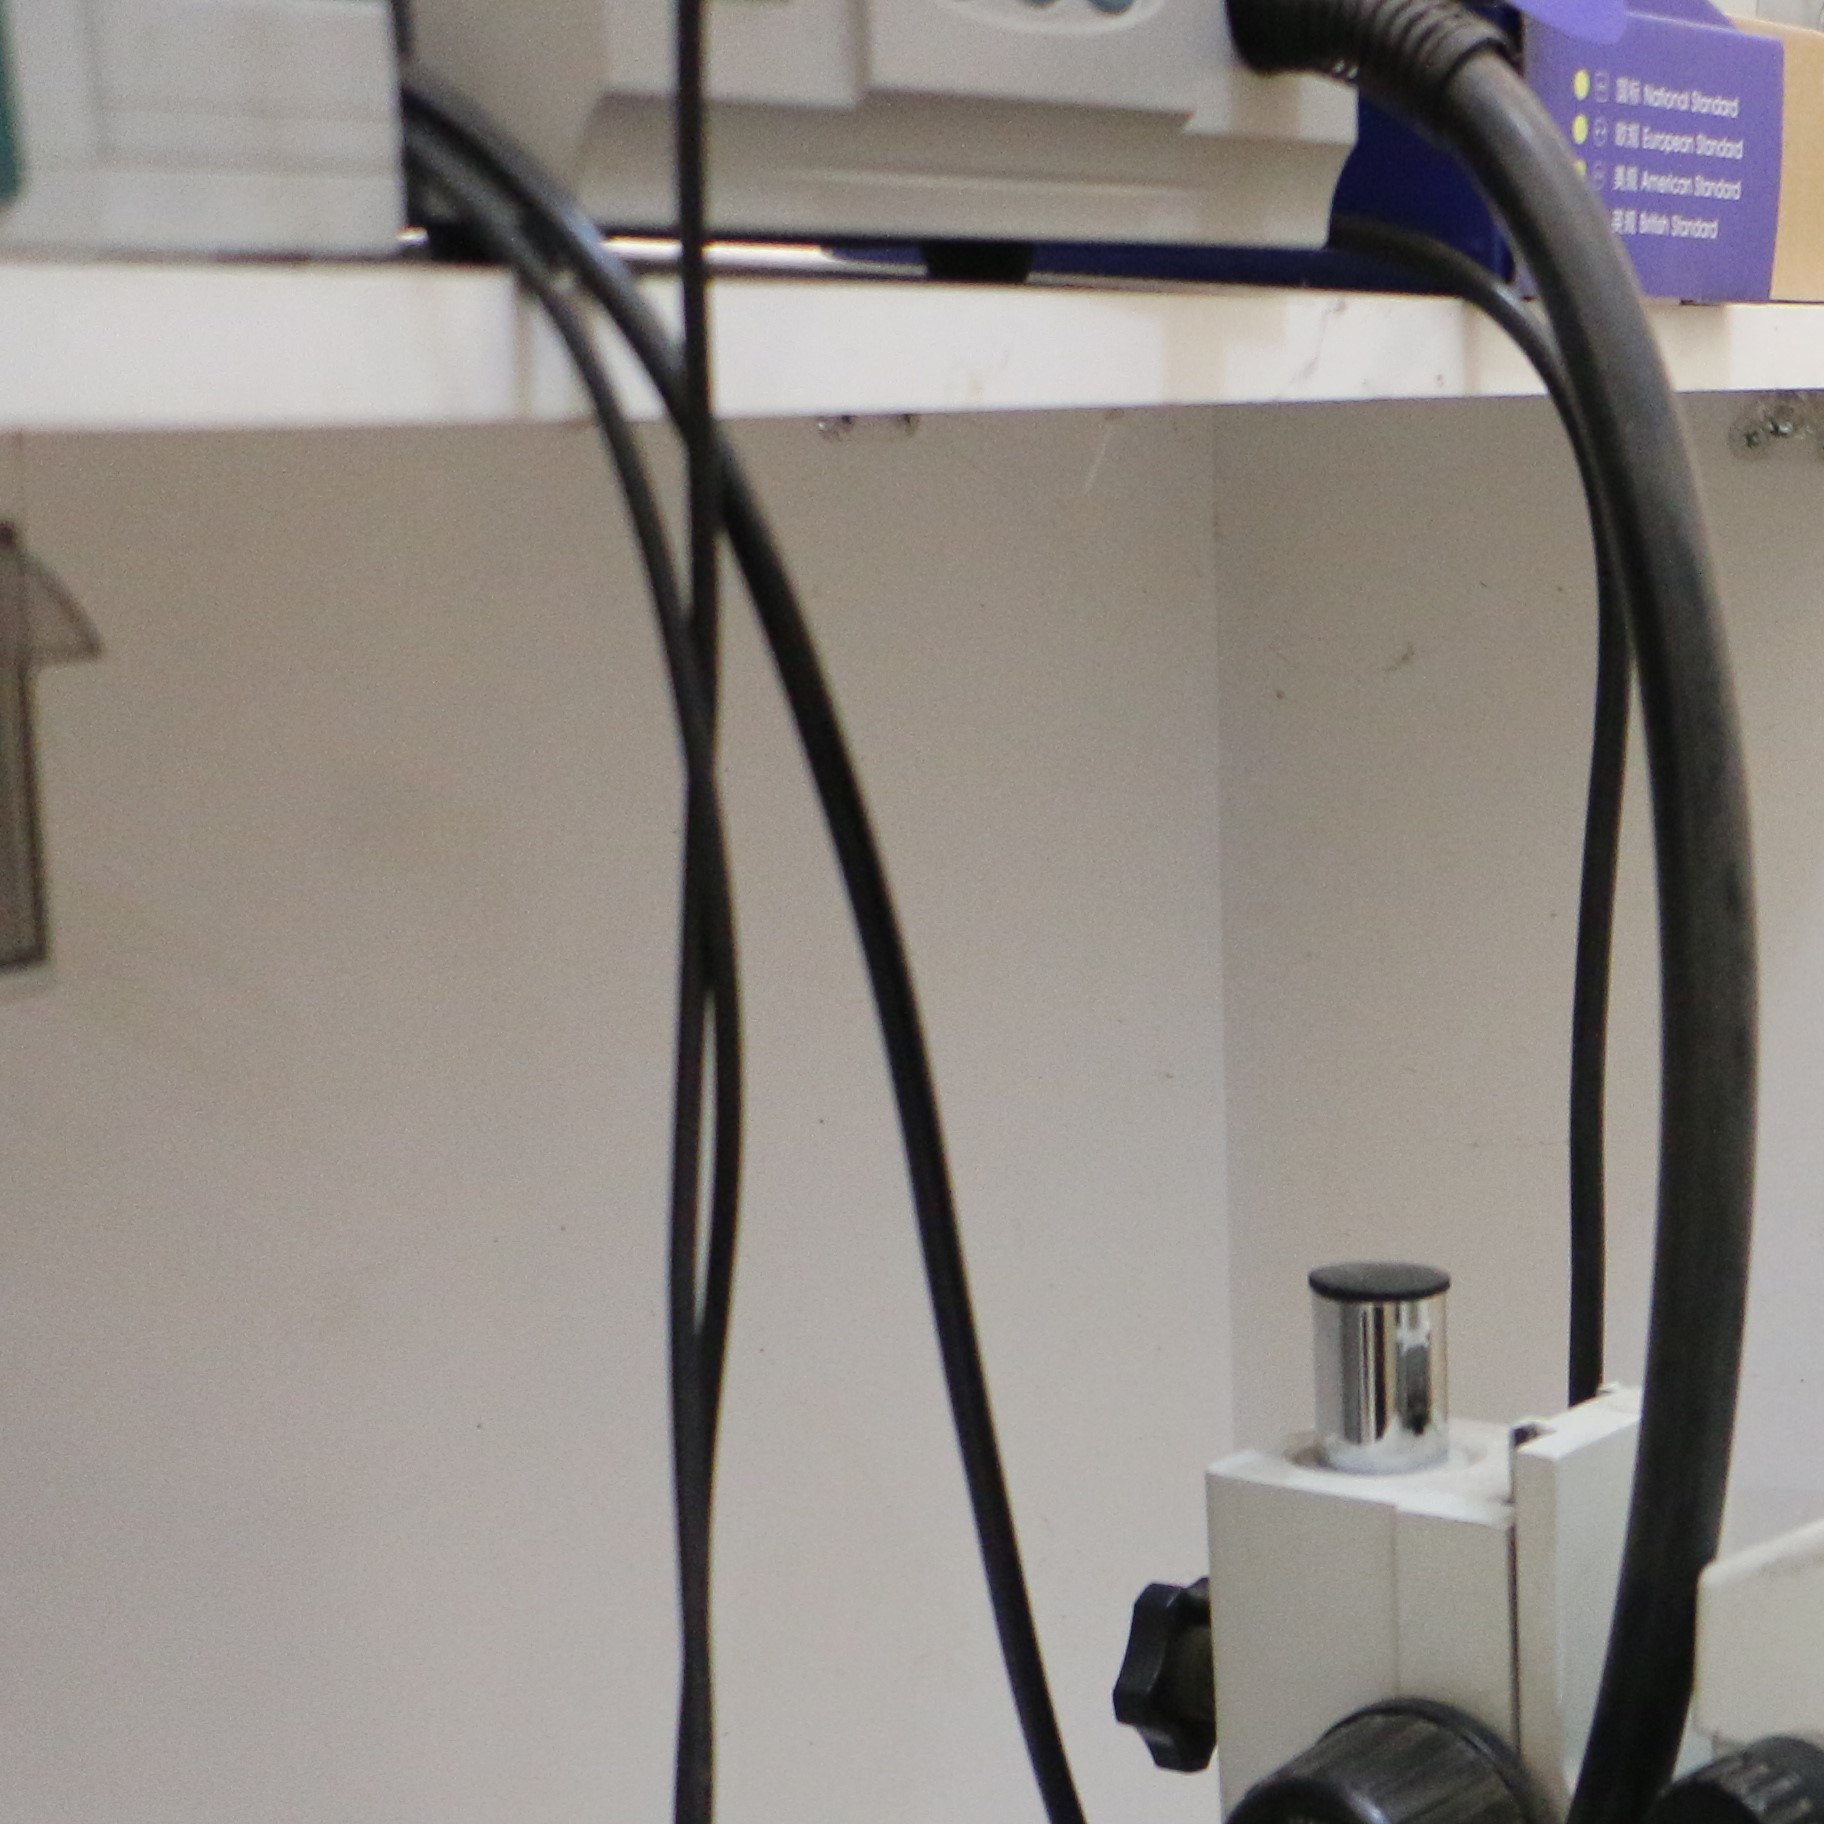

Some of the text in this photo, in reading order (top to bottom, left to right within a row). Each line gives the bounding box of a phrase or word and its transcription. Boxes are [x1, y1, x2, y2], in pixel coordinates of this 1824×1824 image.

[1643, 84, 1690, 111] National
[1690, 90, 1740, 119] Standard
[1642, 126, 1695, 154] European
[1696, 133, 1744, 160] Standard
[1639, 170, 1693, 195] American
[1694, 175, 1742, 201] Standard
[1670, 214, 1719, 239] Standard
